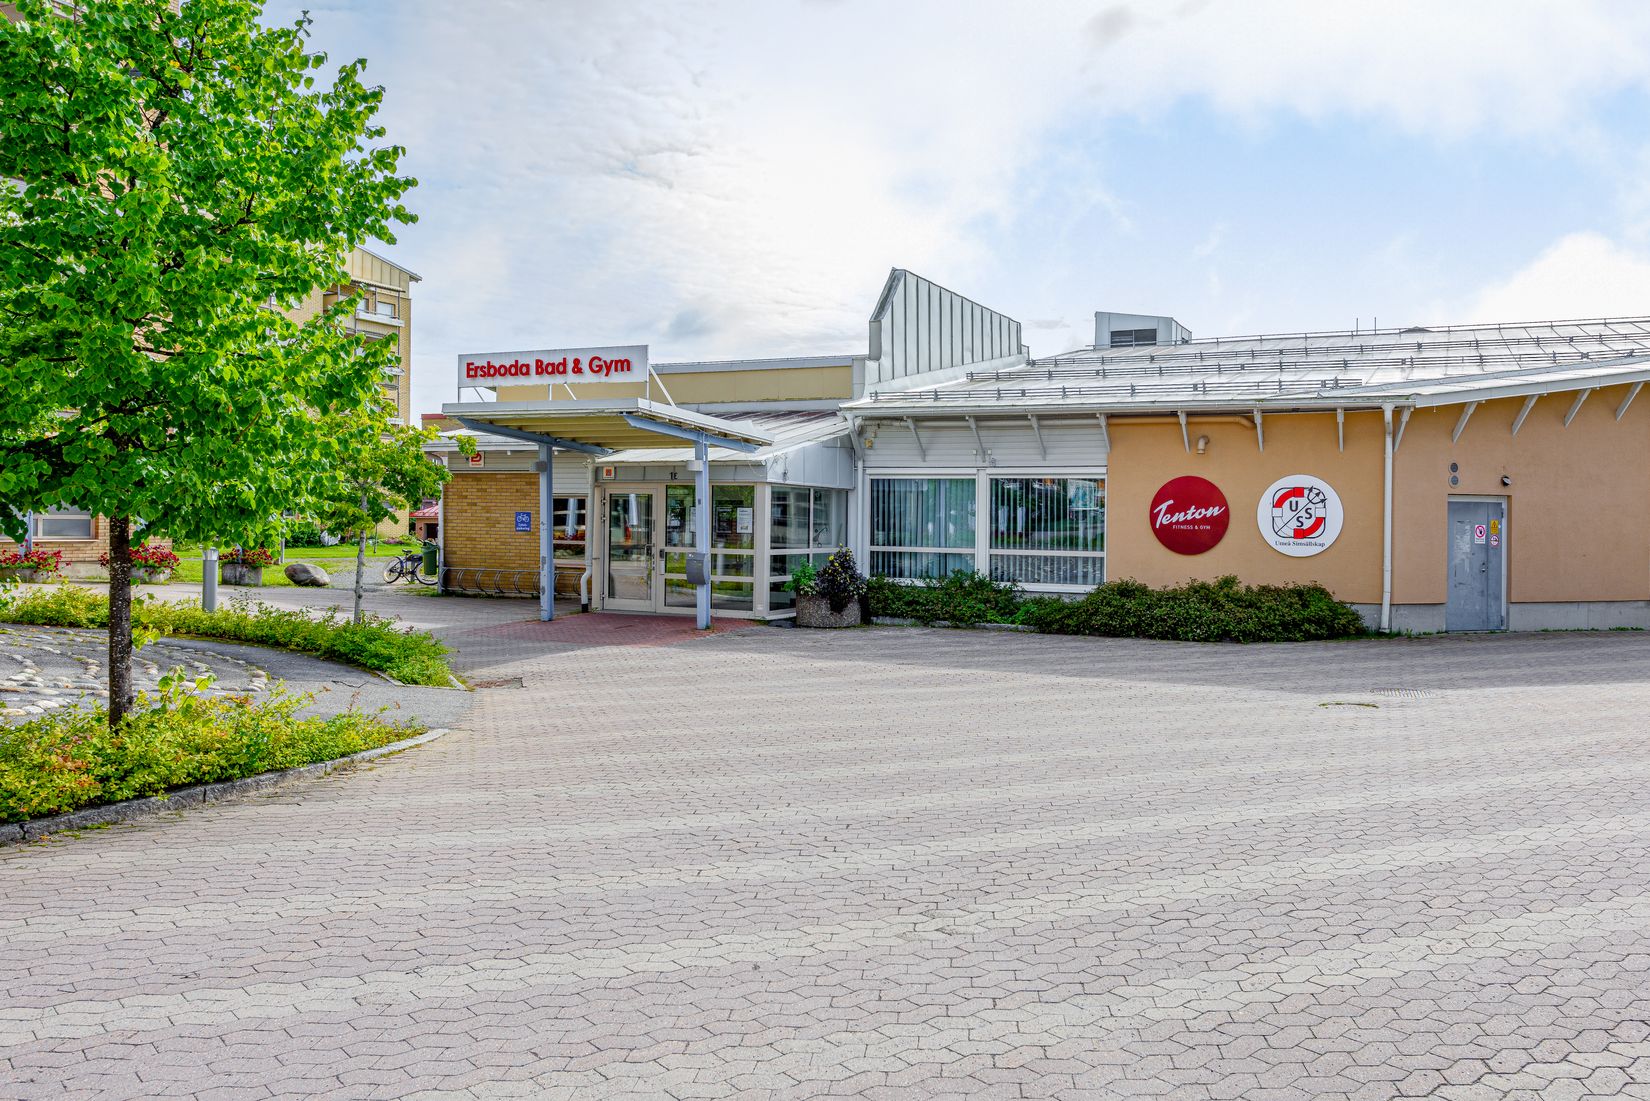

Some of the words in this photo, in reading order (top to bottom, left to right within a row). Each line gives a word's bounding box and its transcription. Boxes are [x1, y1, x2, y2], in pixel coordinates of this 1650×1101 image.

[466, 359, 530, 379] Ersboda
[535, 357, 567, 376] Bad
[571, 358, 583, 374] &
[588, 355, 631, 377] Gym
[1289, 500, 1299, 512] U
[1153, 499, 1226, 529] Tenton
[1304, 507, 1313, 520] S
[1296, 515, 1304, 528] S
